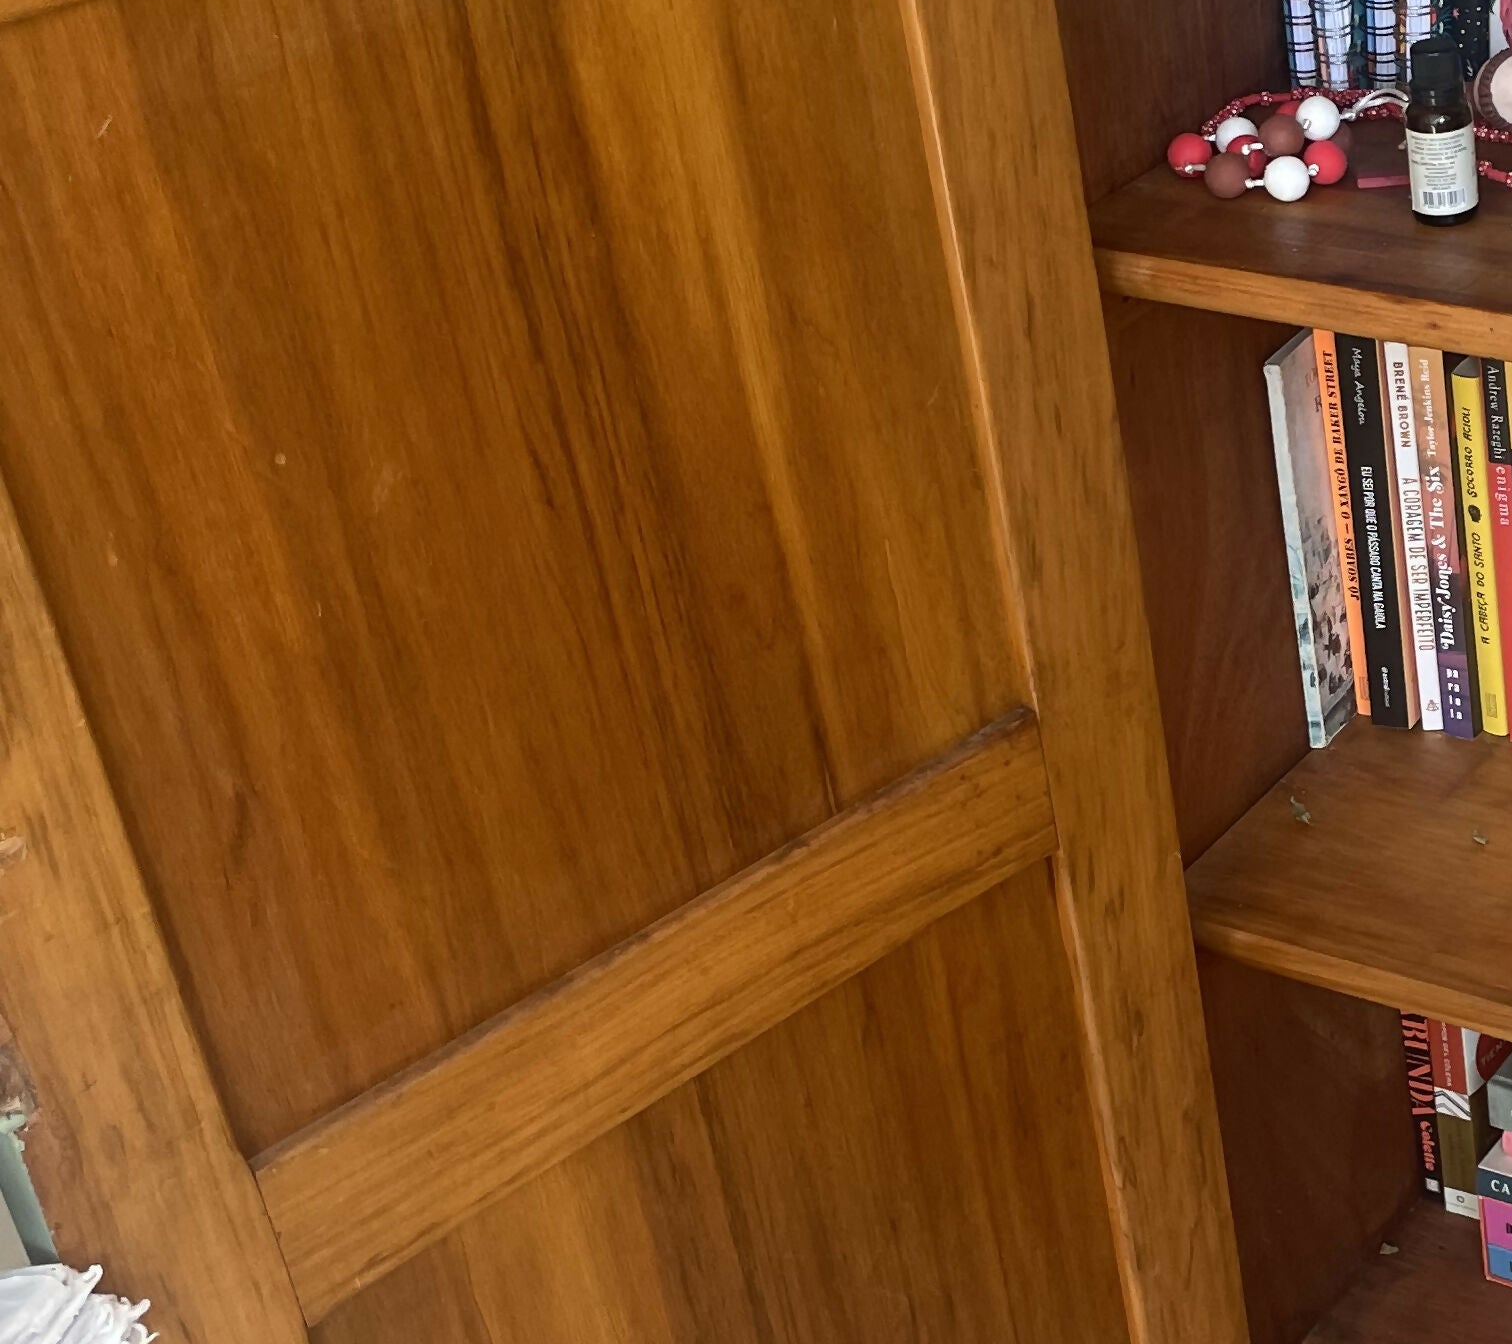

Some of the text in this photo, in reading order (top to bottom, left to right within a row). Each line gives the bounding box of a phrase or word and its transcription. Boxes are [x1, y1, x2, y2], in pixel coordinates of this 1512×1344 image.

[1322, 350, 1337, 398] STREET
[1487, 365, 1502, 413] Andrew
[1354, 380, 1367, 426] Angelou
[1392, 361, 1412, 448] BRENÉ BROWN
[1463, 446, 1478, 498] SOCORRO
[1494, 466, 1511, 527] enigma
[1403, 488, 1436, 651] CORAGEM DE SER IMPERFEITO
[1426, 466, 1457, 650] Daisy The Six
[1472, 532, 1486, 587] DO SANTO
